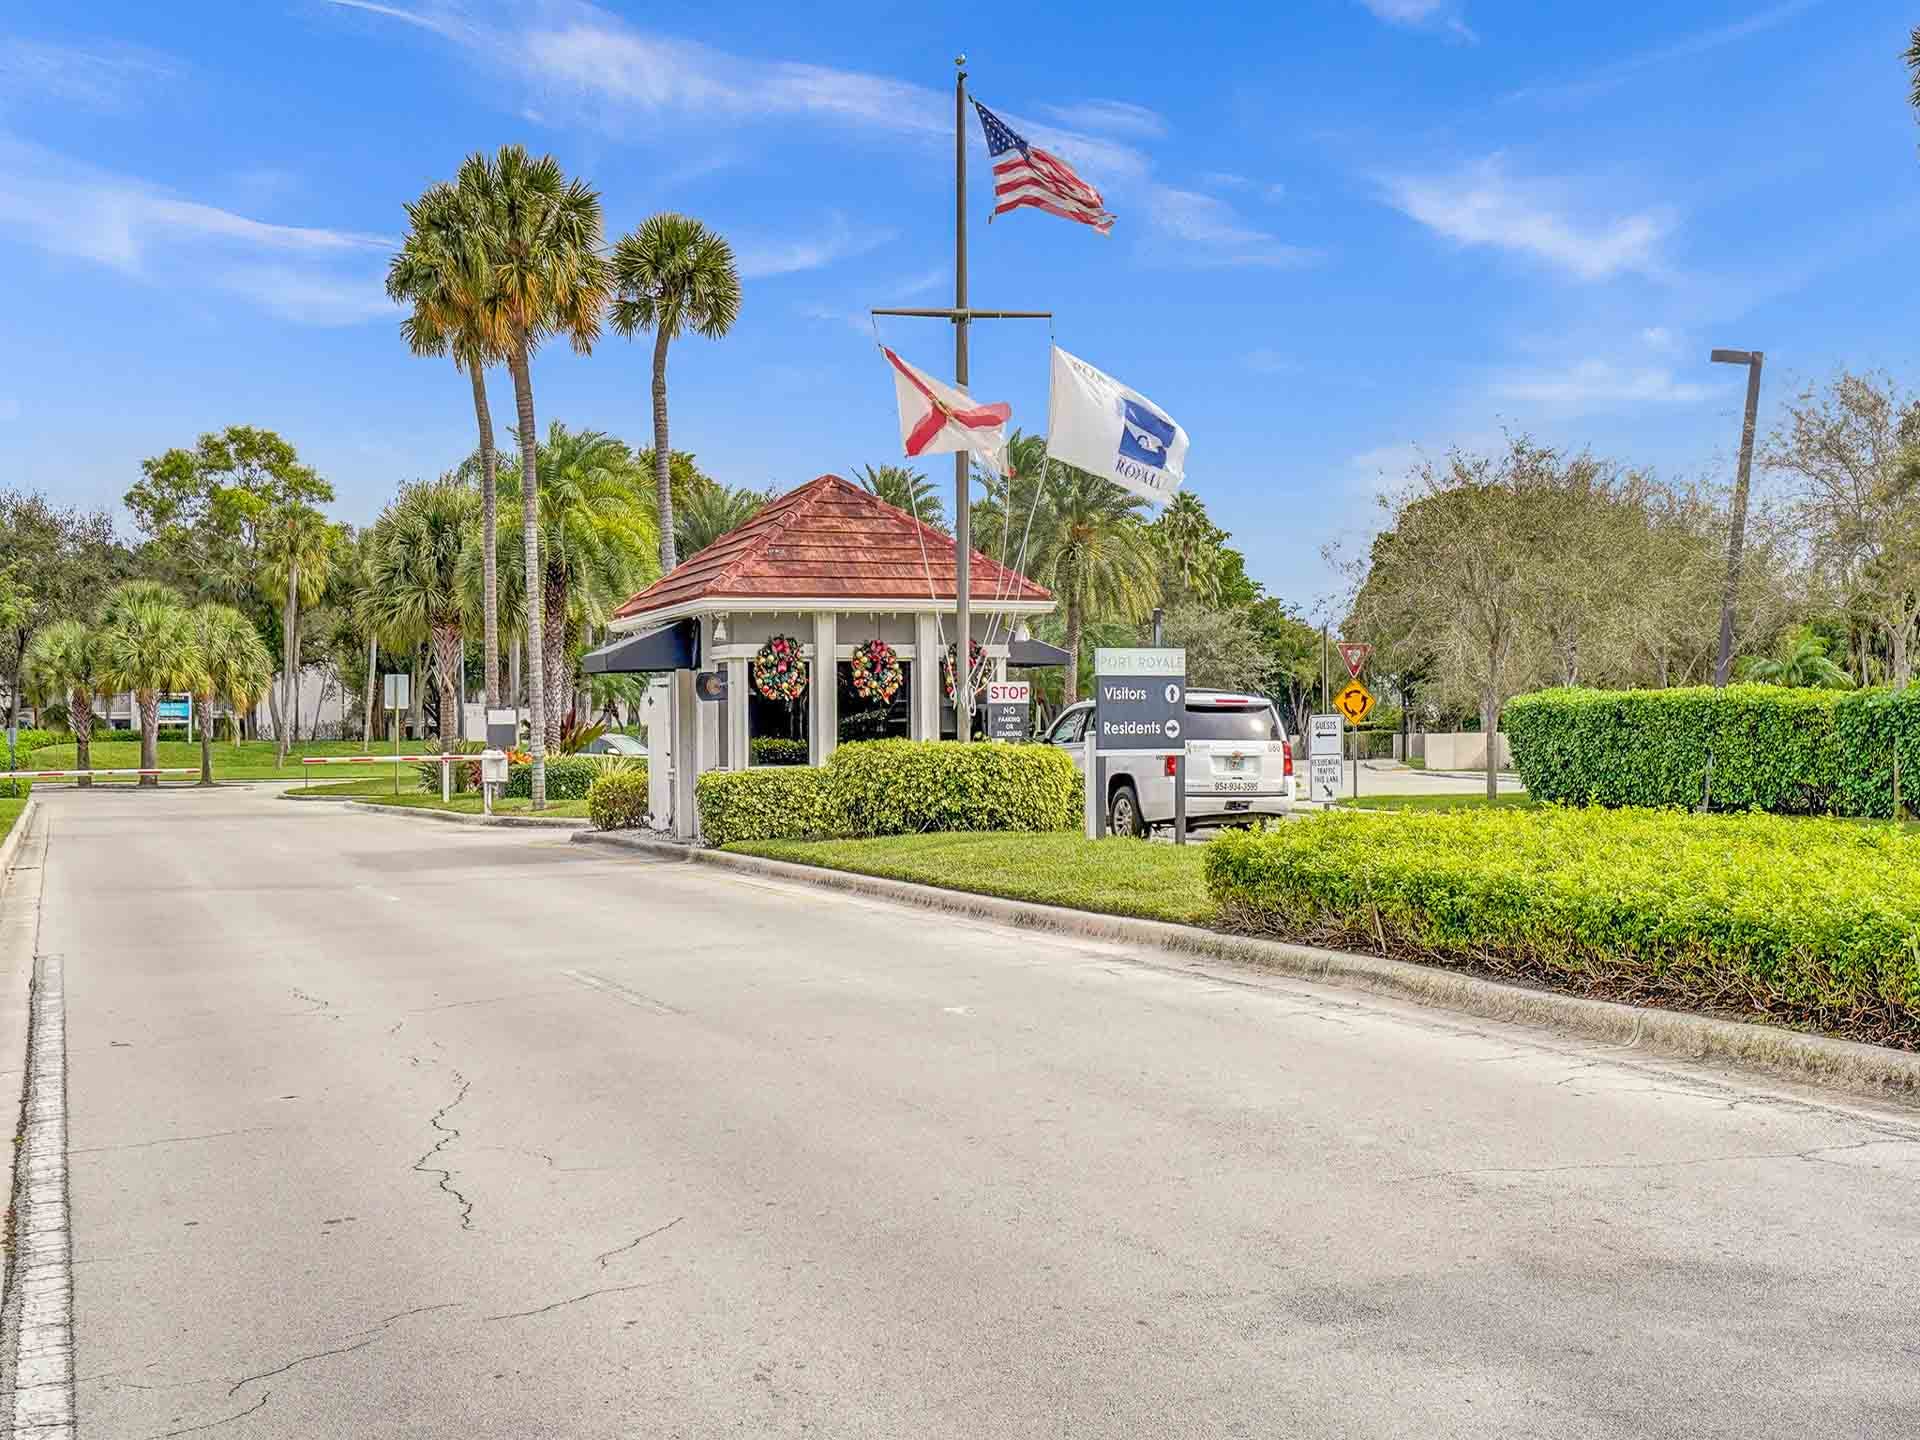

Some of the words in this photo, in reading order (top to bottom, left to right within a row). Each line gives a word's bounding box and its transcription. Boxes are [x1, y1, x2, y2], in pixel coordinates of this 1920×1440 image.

[1138, 656, 1184, 669] ROYALE
[991, 686, 1028, 699] STOP
[1104, 687, 1147, 700] Visitors
[1002, 706, 1016, 714] NO
[1104, 721, 1161, 735] Residents
[1315, 721, 1337, 730] GUESTS
